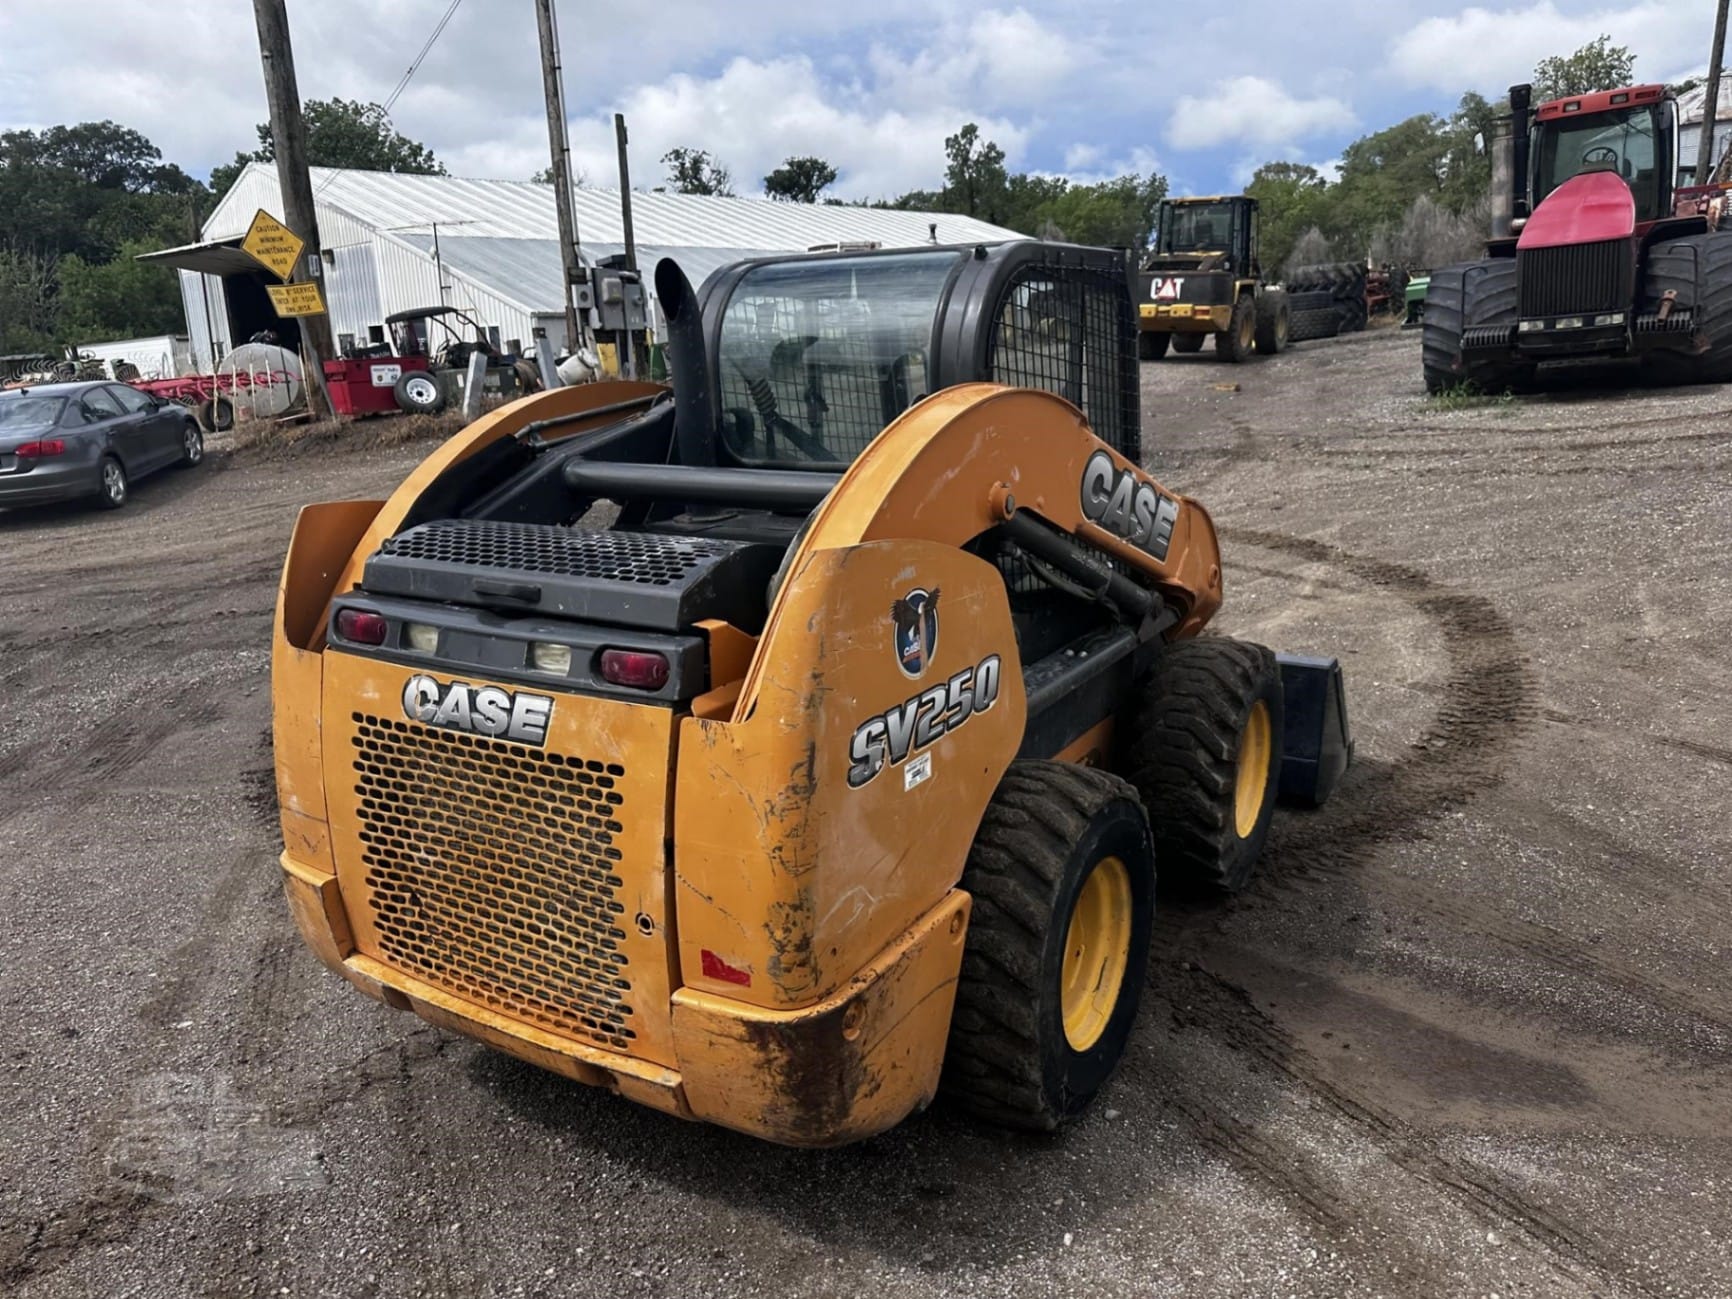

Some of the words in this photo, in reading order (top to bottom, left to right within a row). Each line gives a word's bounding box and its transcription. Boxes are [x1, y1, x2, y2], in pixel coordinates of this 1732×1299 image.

[256, 225, 280, 233] CAUTION
[256, 246, 295, 255] MAINTENANCE
[272, 257, 288, 265] ROAD
[293, 285, 315, 294] SERVICE
[1150, 278, 1185, 300] CAT
[1081, 450, 1178, 560] CASE
[402, 674, 555, 746] CASE
[847, 653, 1001, 788] SV250
